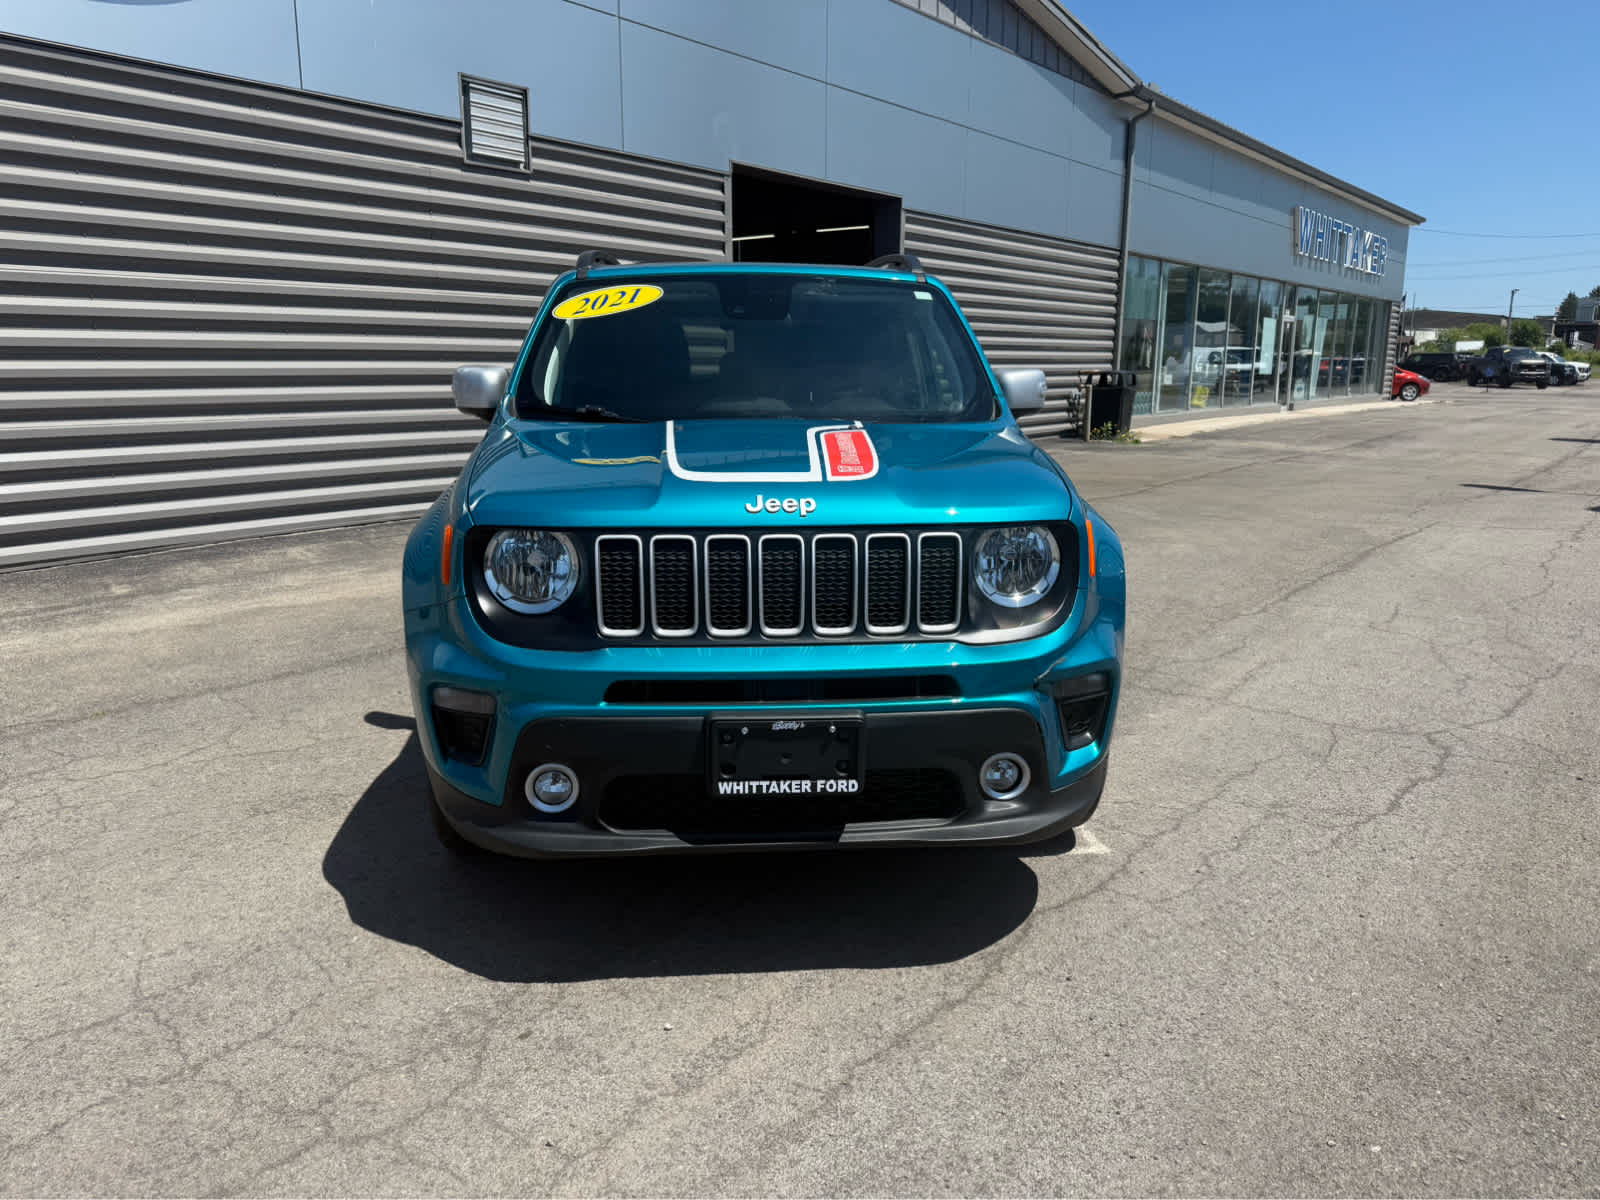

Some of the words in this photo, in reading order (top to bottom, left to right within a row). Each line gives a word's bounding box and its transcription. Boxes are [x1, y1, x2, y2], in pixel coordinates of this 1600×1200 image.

[1298, 206, 1388, 276] WHITTAKER
[572, 288, 642, 315] 2021
[745, 494, 817, 517] Jeep
[718, 780, 812, 795] WHITTAKER
[816, 779, 860, 793] FORD
